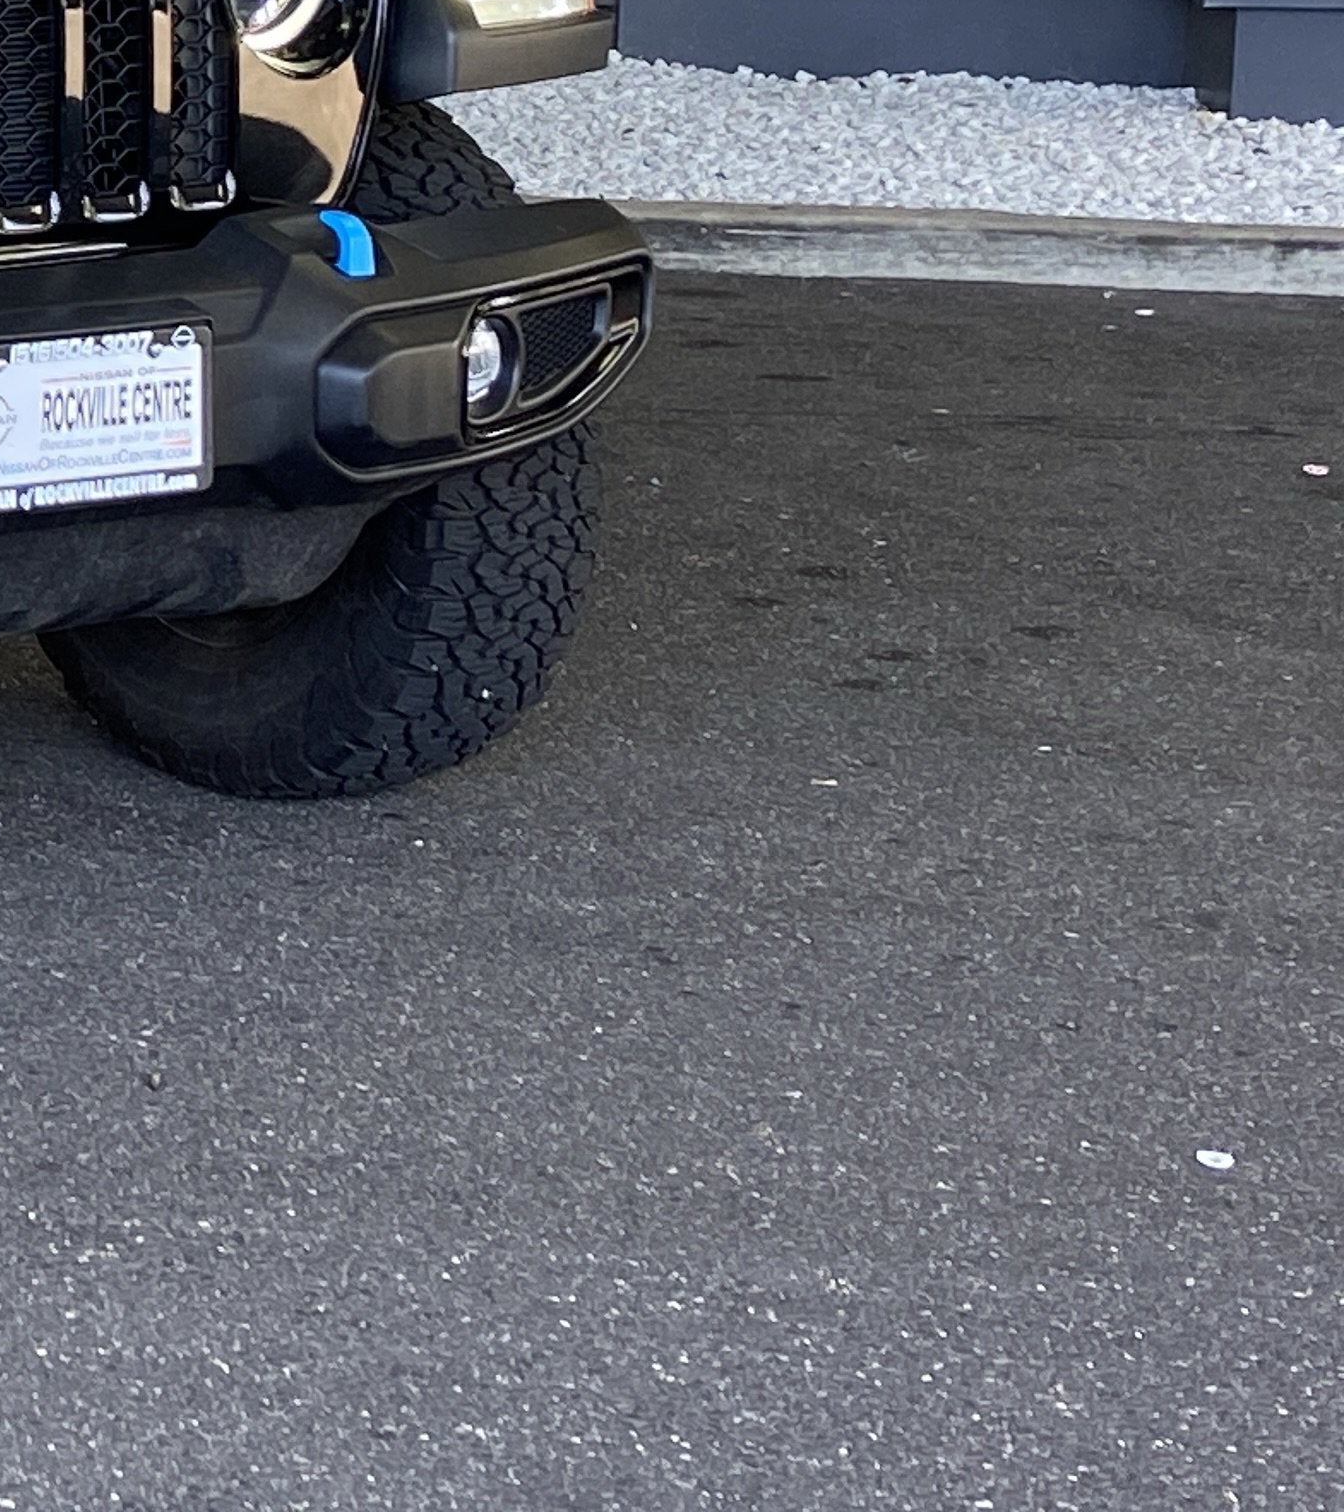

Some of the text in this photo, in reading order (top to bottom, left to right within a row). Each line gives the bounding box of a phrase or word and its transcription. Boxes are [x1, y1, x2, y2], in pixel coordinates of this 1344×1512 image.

[78, 369, 133, 383] NISSAN
[41, 378, 193, 433] ROCKVILLE CENTRE
